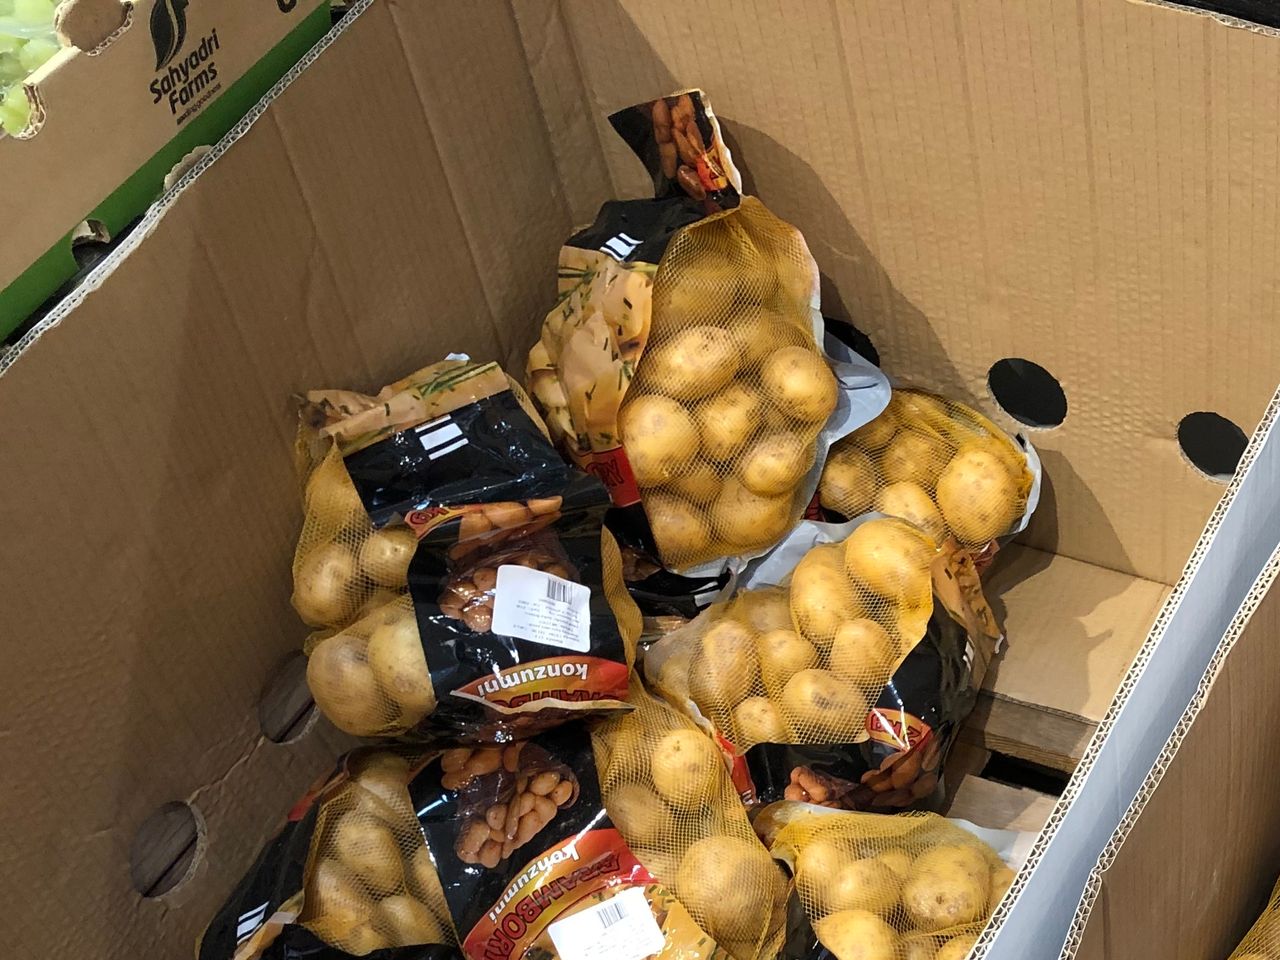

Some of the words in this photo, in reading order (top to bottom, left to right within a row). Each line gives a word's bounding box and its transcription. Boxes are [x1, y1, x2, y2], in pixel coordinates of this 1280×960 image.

[150, 28, 220, 104] Sahyadri
[168, 62, 218, 114] Farms
[488, 843, 580, 923] konzumní
